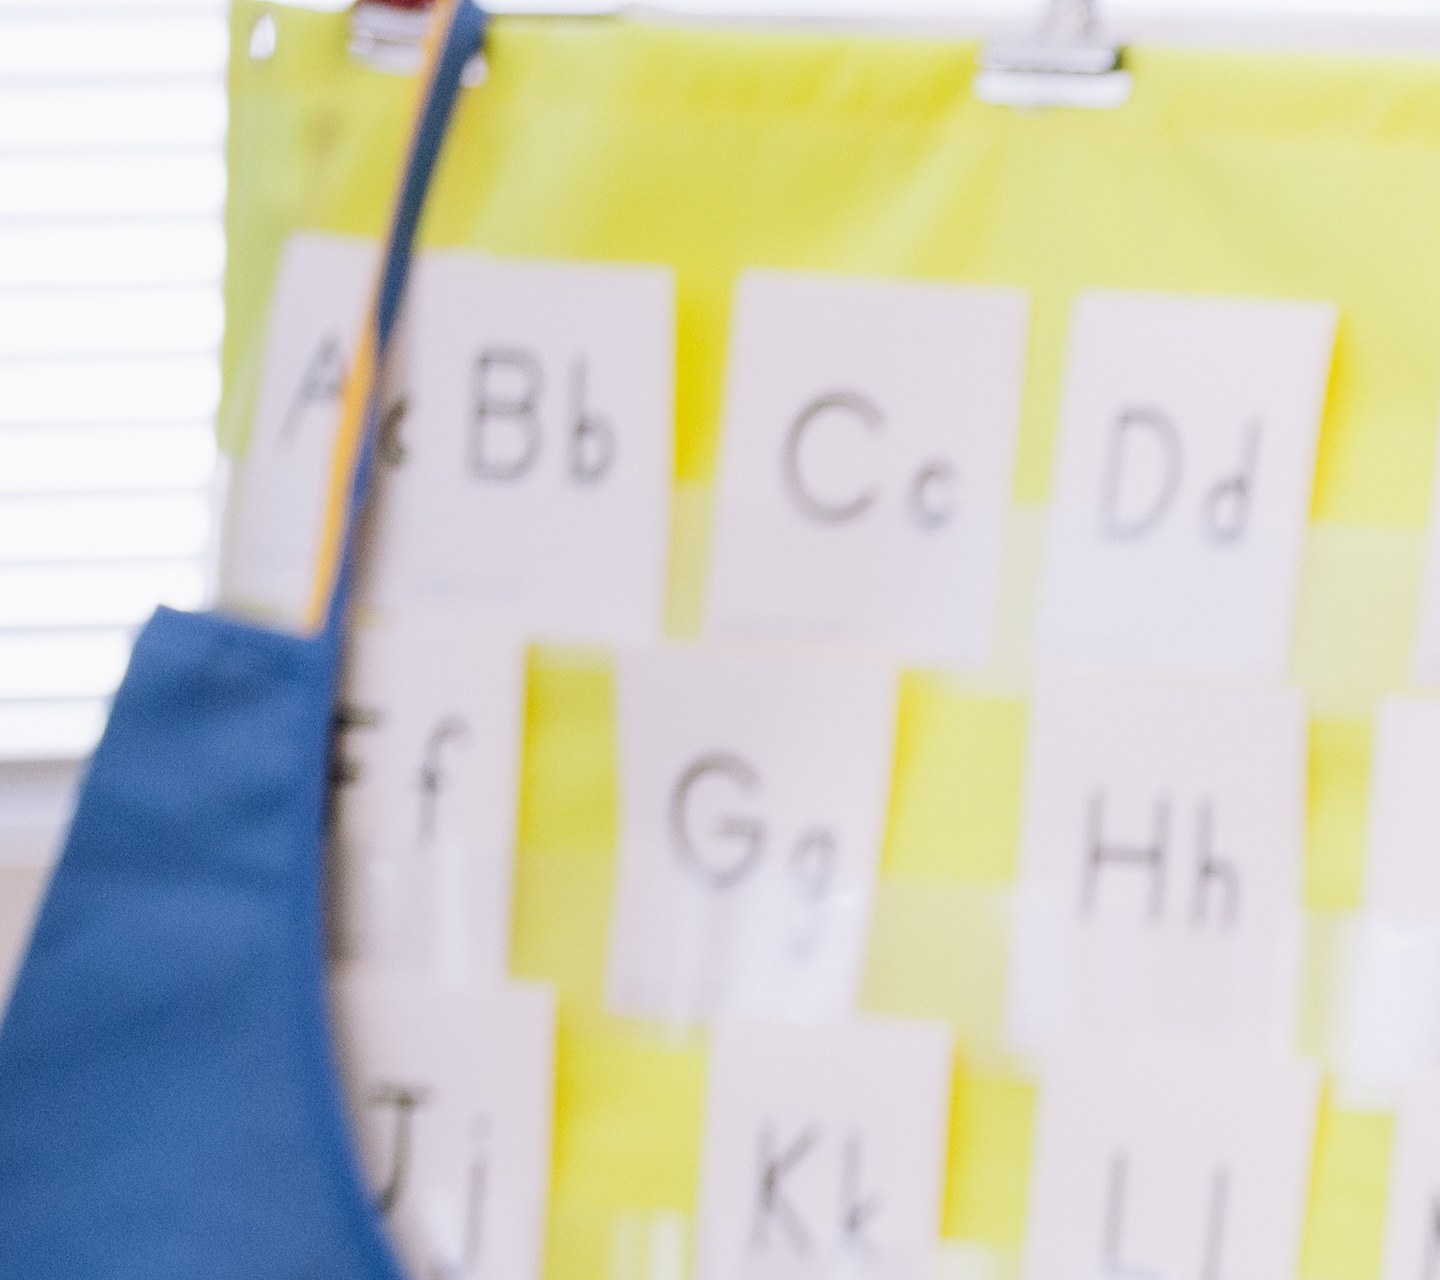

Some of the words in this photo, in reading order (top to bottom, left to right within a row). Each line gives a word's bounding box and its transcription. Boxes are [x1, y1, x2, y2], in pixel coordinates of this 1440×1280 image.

[465, 345, 617, 488] Bb
[782, 388, 960, 530] Cc
[1098, 406, 1264, 548] Dd
[668, 748, 838, 965] Gg
[1077, 787, 1243, 931] Hh
[752, 1114, 882, 1266] Kk
